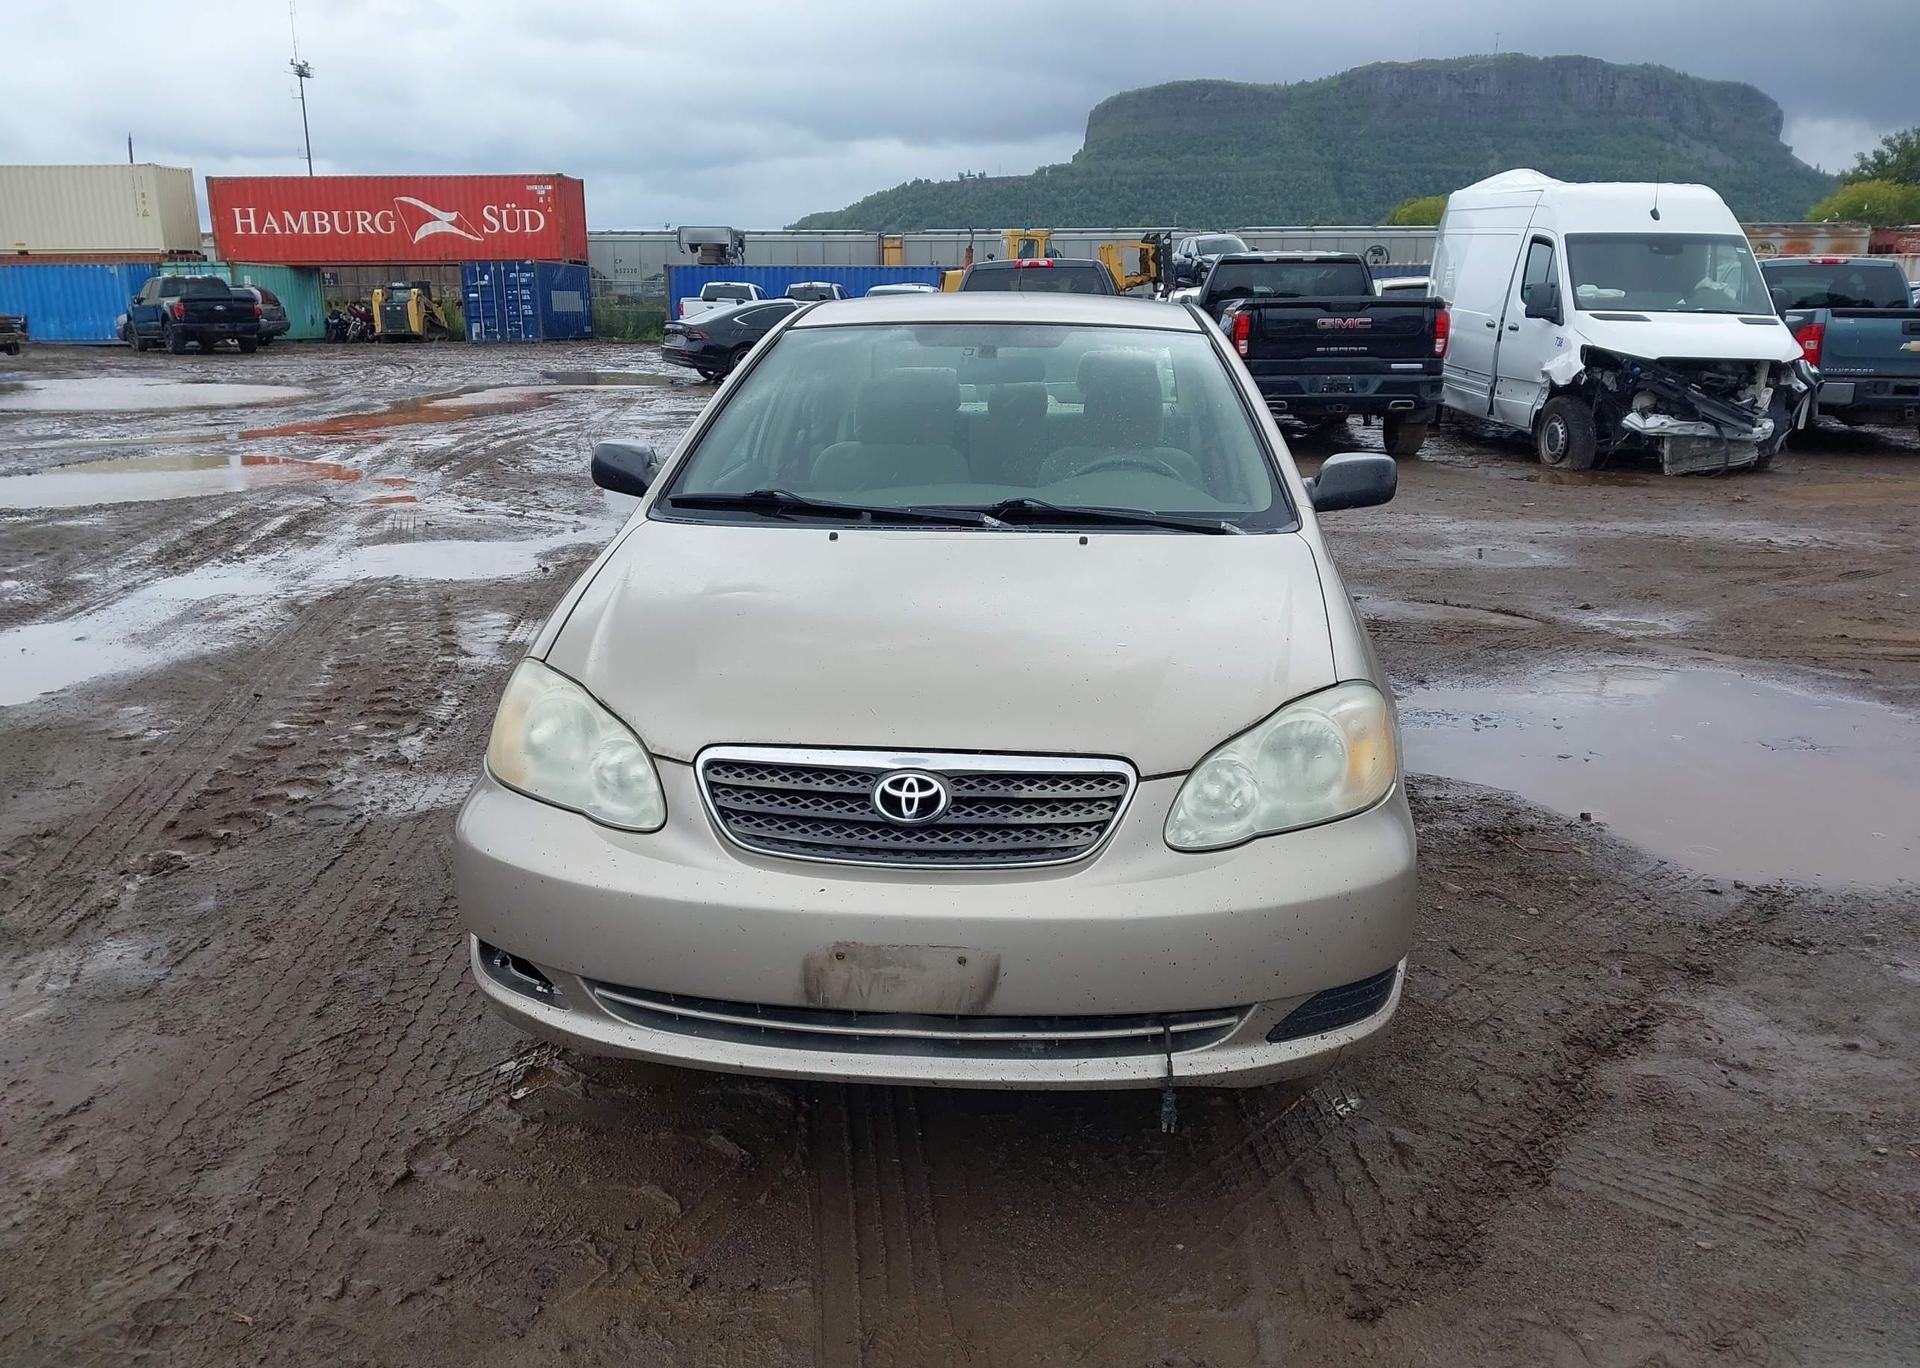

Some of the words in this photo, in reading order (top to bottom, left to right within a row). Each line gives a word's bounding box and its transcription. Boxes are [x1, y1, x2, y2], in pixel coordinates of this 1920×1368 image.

[232, 207, 396, 234] HAMBURG
[483, 203, 545, 233] SÜD
[1317, 318, 1372, 329] GMC
